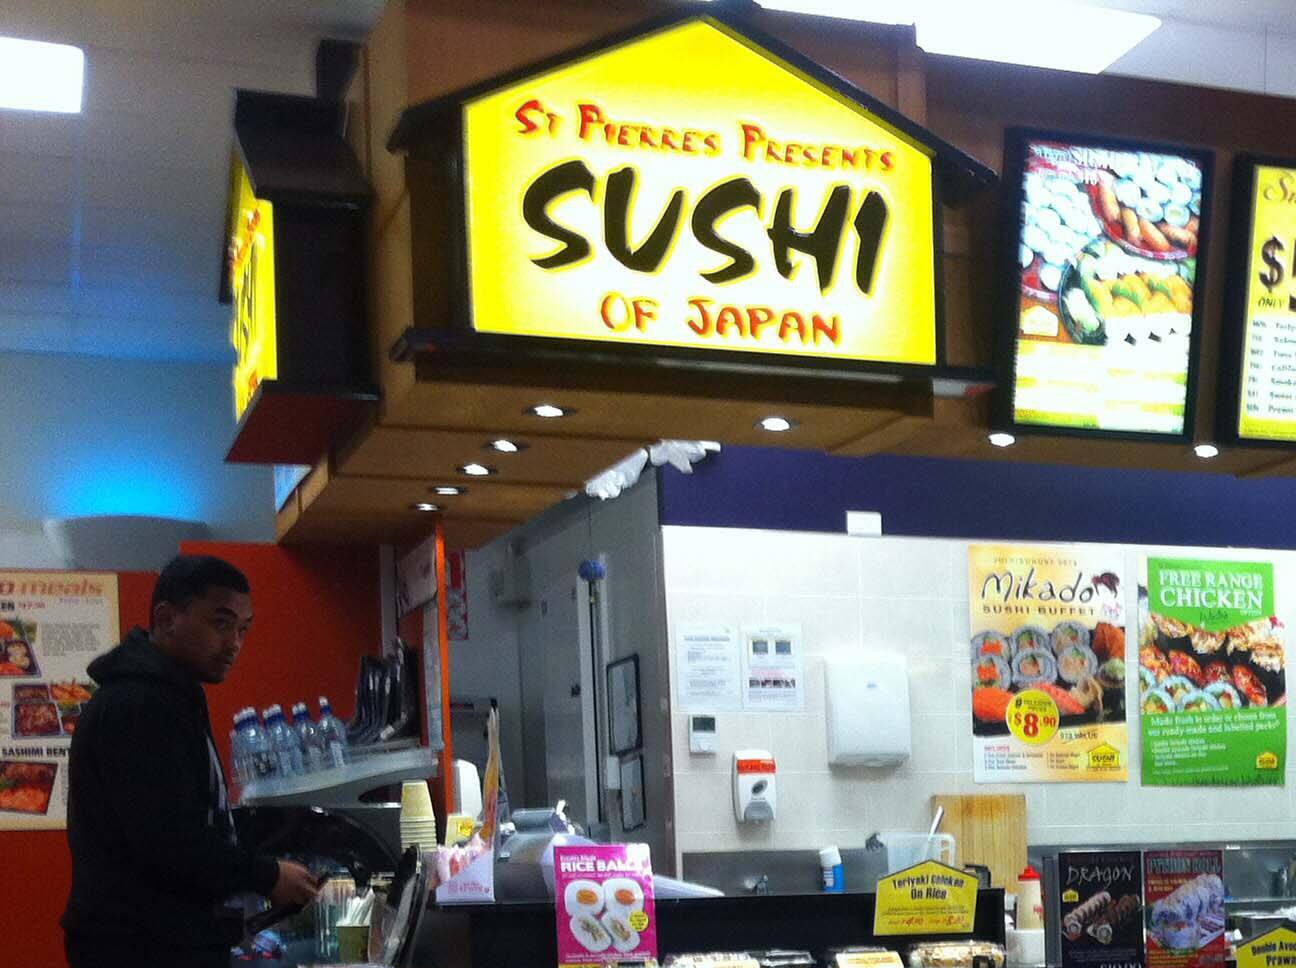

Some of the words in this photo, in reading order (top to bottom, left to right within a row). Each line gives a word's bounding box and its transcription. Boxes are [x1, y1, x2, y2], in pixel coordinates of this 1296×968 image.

[522, 160, 890, 296] SUSHI
[601, 291, 659, 331] OF
[687, 298, 841, 345] JAPAN
[981, 568, 1094, 603] Mikado
[1159, 569, 1201, 587] FREE
[1205, 571, 1263, 590] RANGE
[1160, 588, 1263, 609] CHICKEN
[983, 605, 1030, 614] SUSHI
[1038, 606, 1095, 616] BUFFET
[1014, 712, 1056, 737] $8.90
[561, 861, 594, 872] RICE
[1066, 865, 1136, 889] DRAGON
[910, 888, 923, 900] On
[925, 887, 947, 900] Rice
[1266, 954, 1296, 967] Prawn
